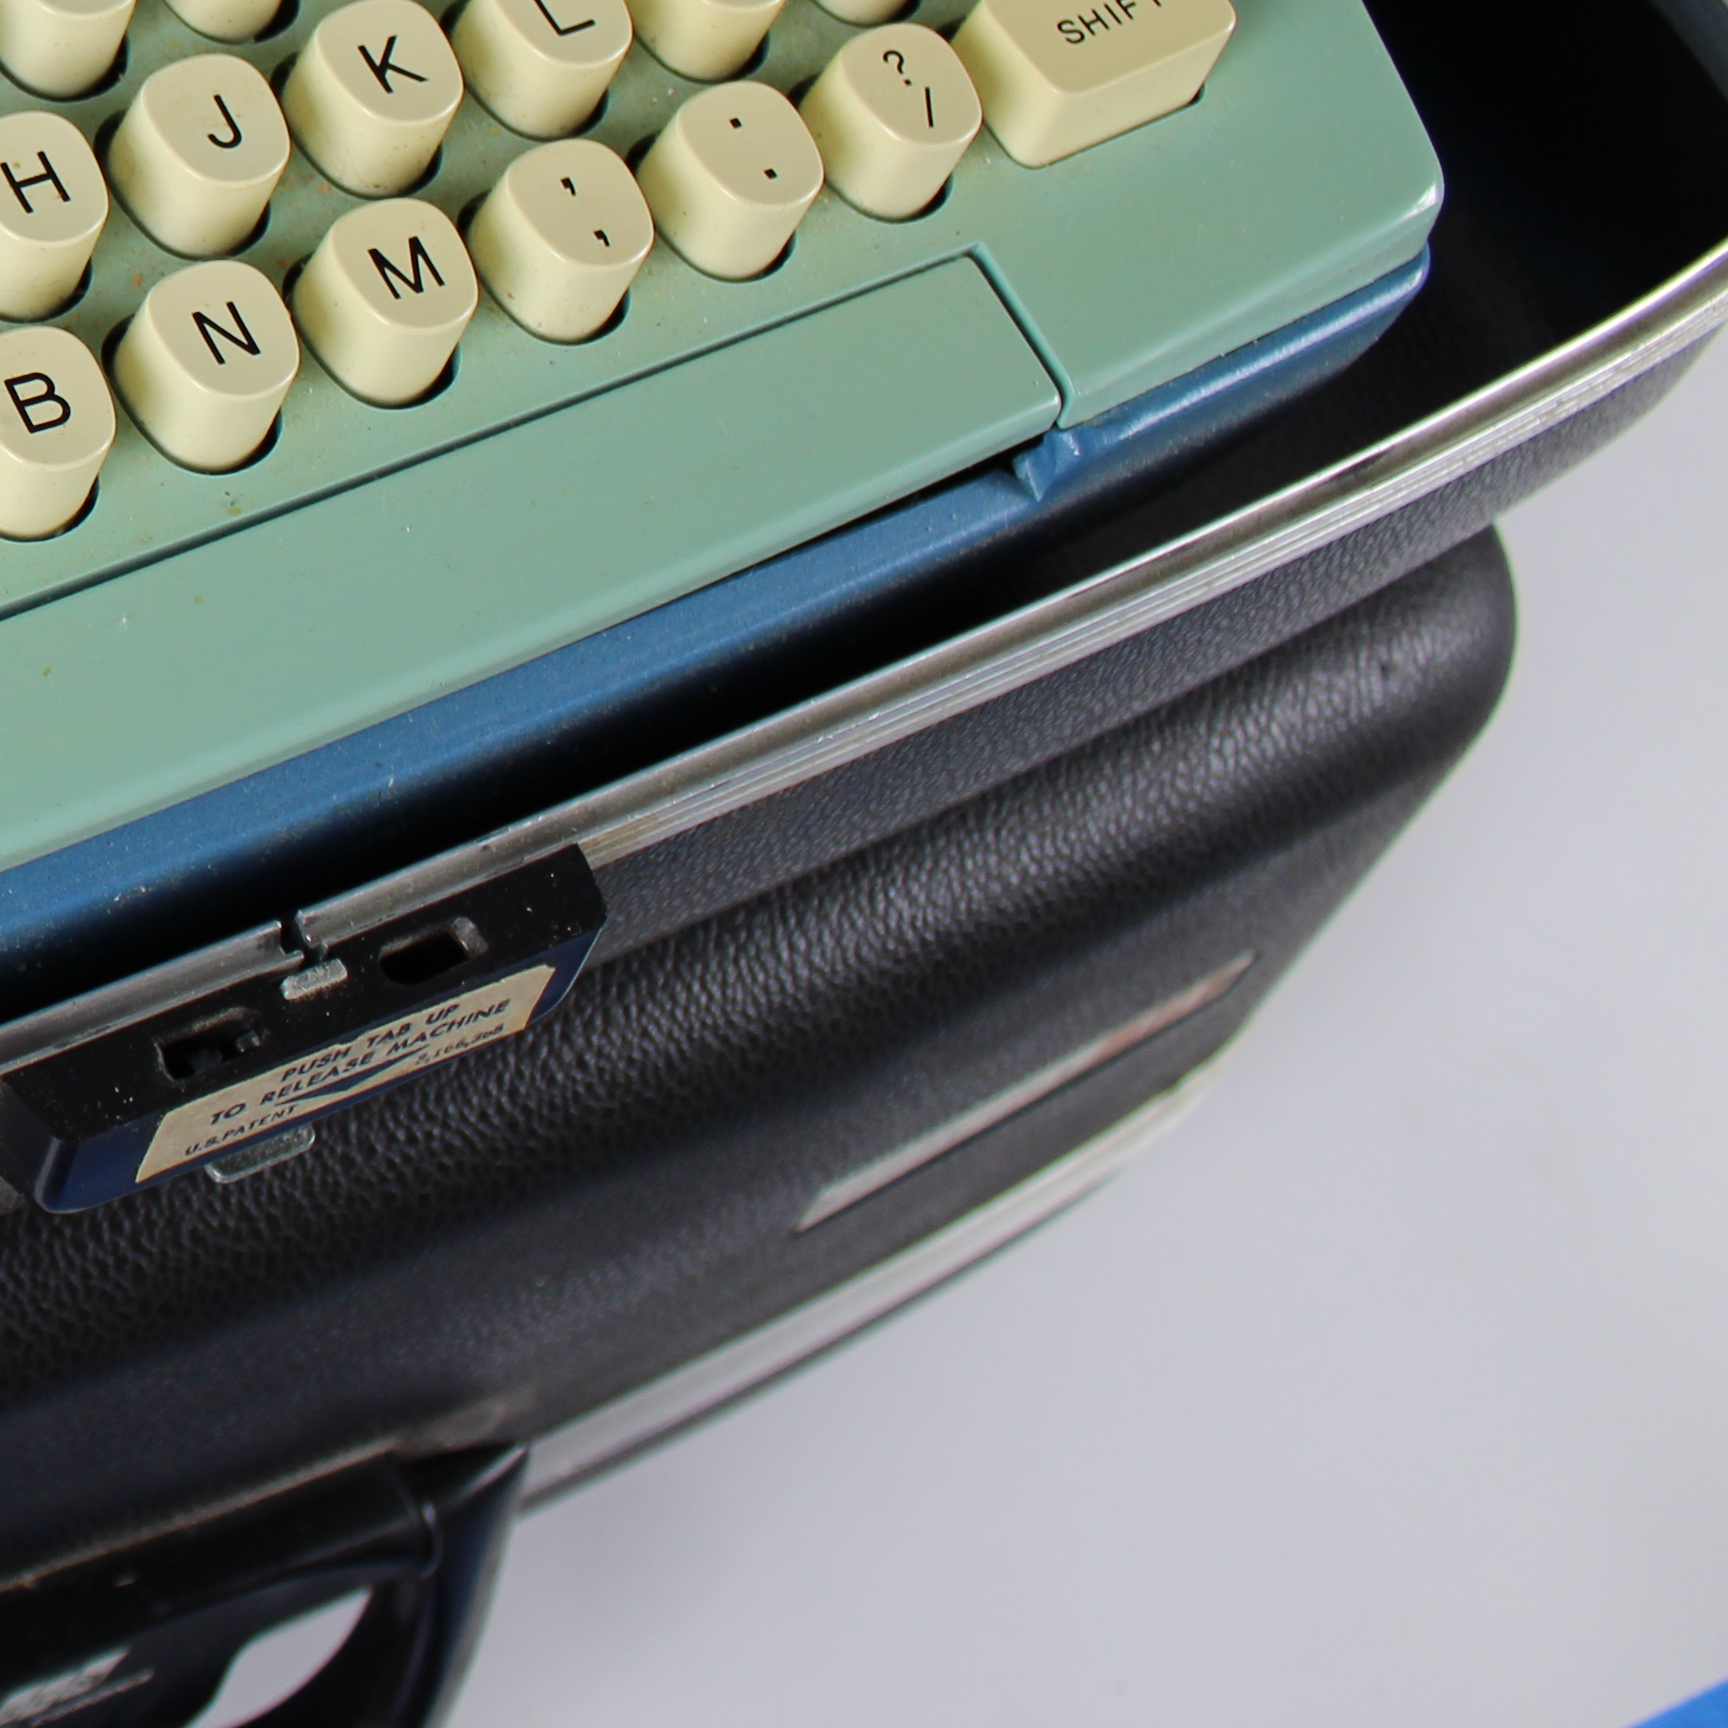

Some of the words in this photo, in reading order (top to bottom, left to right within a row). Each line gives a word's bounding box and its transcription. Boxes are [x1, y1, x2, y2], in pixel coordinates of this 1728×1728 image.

[357, 35, 427, 94] K
[882, 50, 912, 86] ?
[207, 94, 242, 149] J
[0, 150, 71, 214] H
[367, 236, 445, 300] M
[191, 301, 261, 365] N
[3, 372, 72, 434] B
[211, 1103, 247, 1126] TO
[260, 1051, 376, 1106] RELEASE
[387, 999, 512, 1057] MACHINE
[282, 1047, 351, 1082] PUSH
[368, 1023, 413, 1048] TAB
[426, 1003, 461, 1024] UP
